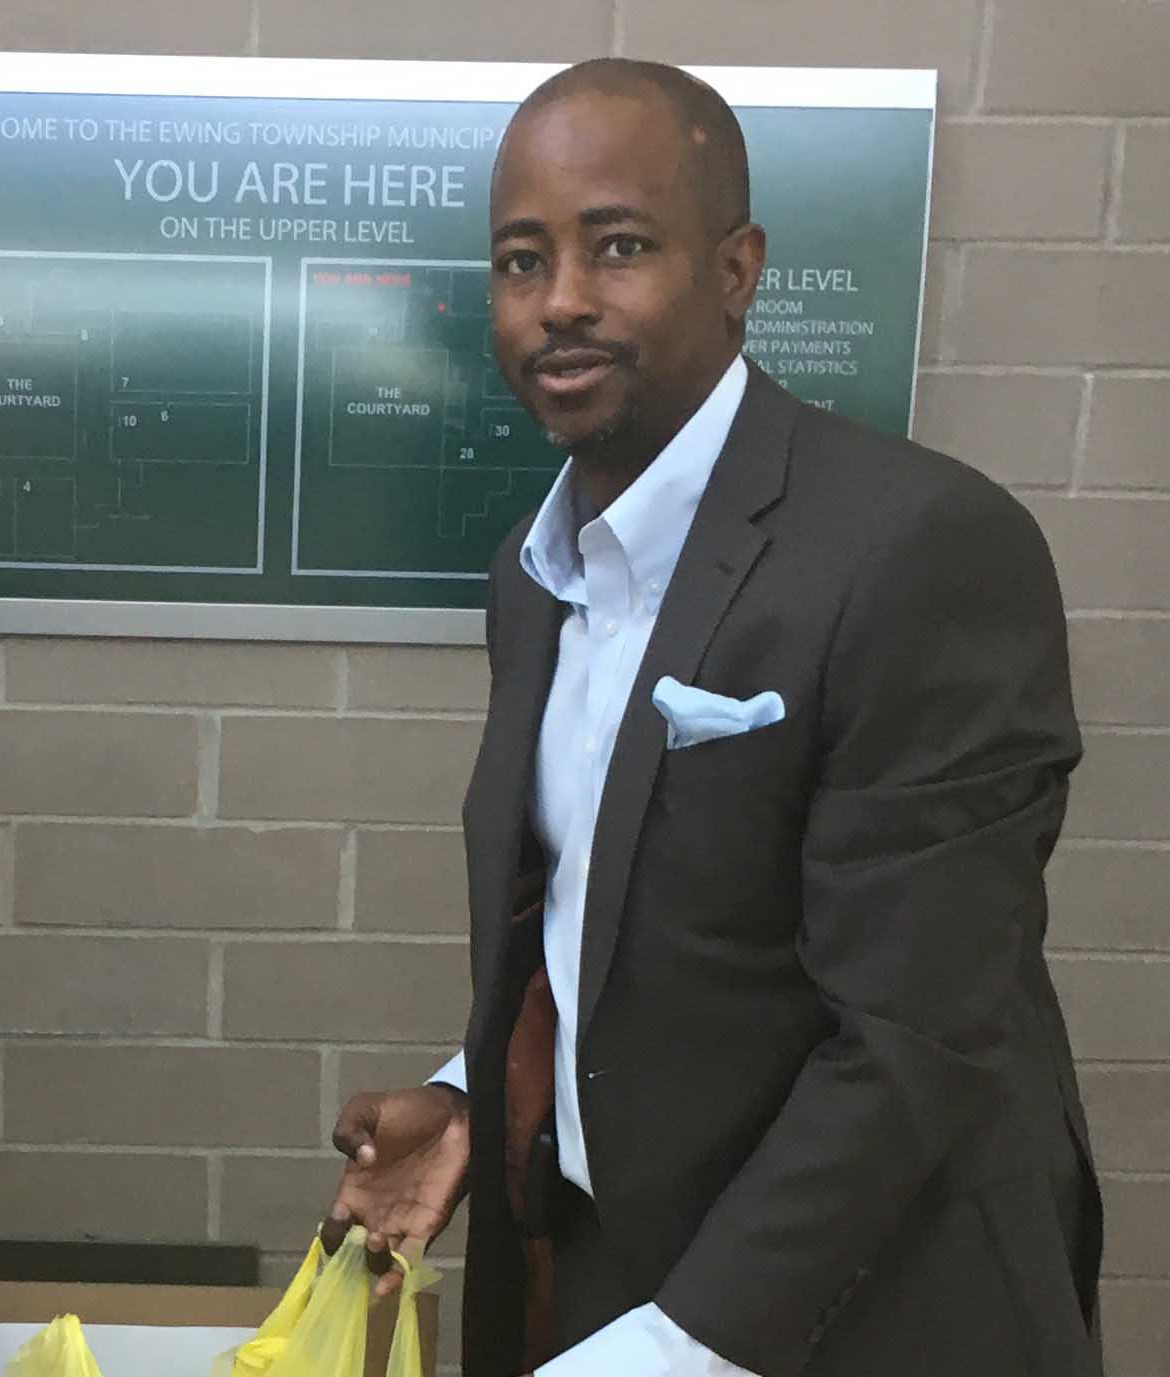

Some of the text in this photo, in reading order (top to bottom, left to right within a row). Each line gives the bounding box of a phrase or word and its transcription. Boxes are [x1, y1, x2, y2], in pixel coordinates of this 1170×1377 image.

[65, 118, 98, 141] TO
[105, 120, 152, 142] THE
[159, 120, 241, 145] EWING
[248, 122, 380, 146] TOWNSHIP
[114, 159, 465, 207] YOU ARE HERE
[160, 216, 414, 243] ON THE UPPER LEVEL
[788, 269, 859, 292] LEVEL
[756, 300, 803, 314] ROOM
[745, 320, 874, 335] ADMINISTRATION
[771, 341, 851, 354] PAYMENTS
[778, 360, 858, 375] STATISTICS
[7, 378, 32, 391] THE
[377, 387, 401, 398] THE
[347, 403, 430, 415] COURTYARD
[123, 416, 137, 426] 10
[496, 425, 510, 436] 30
